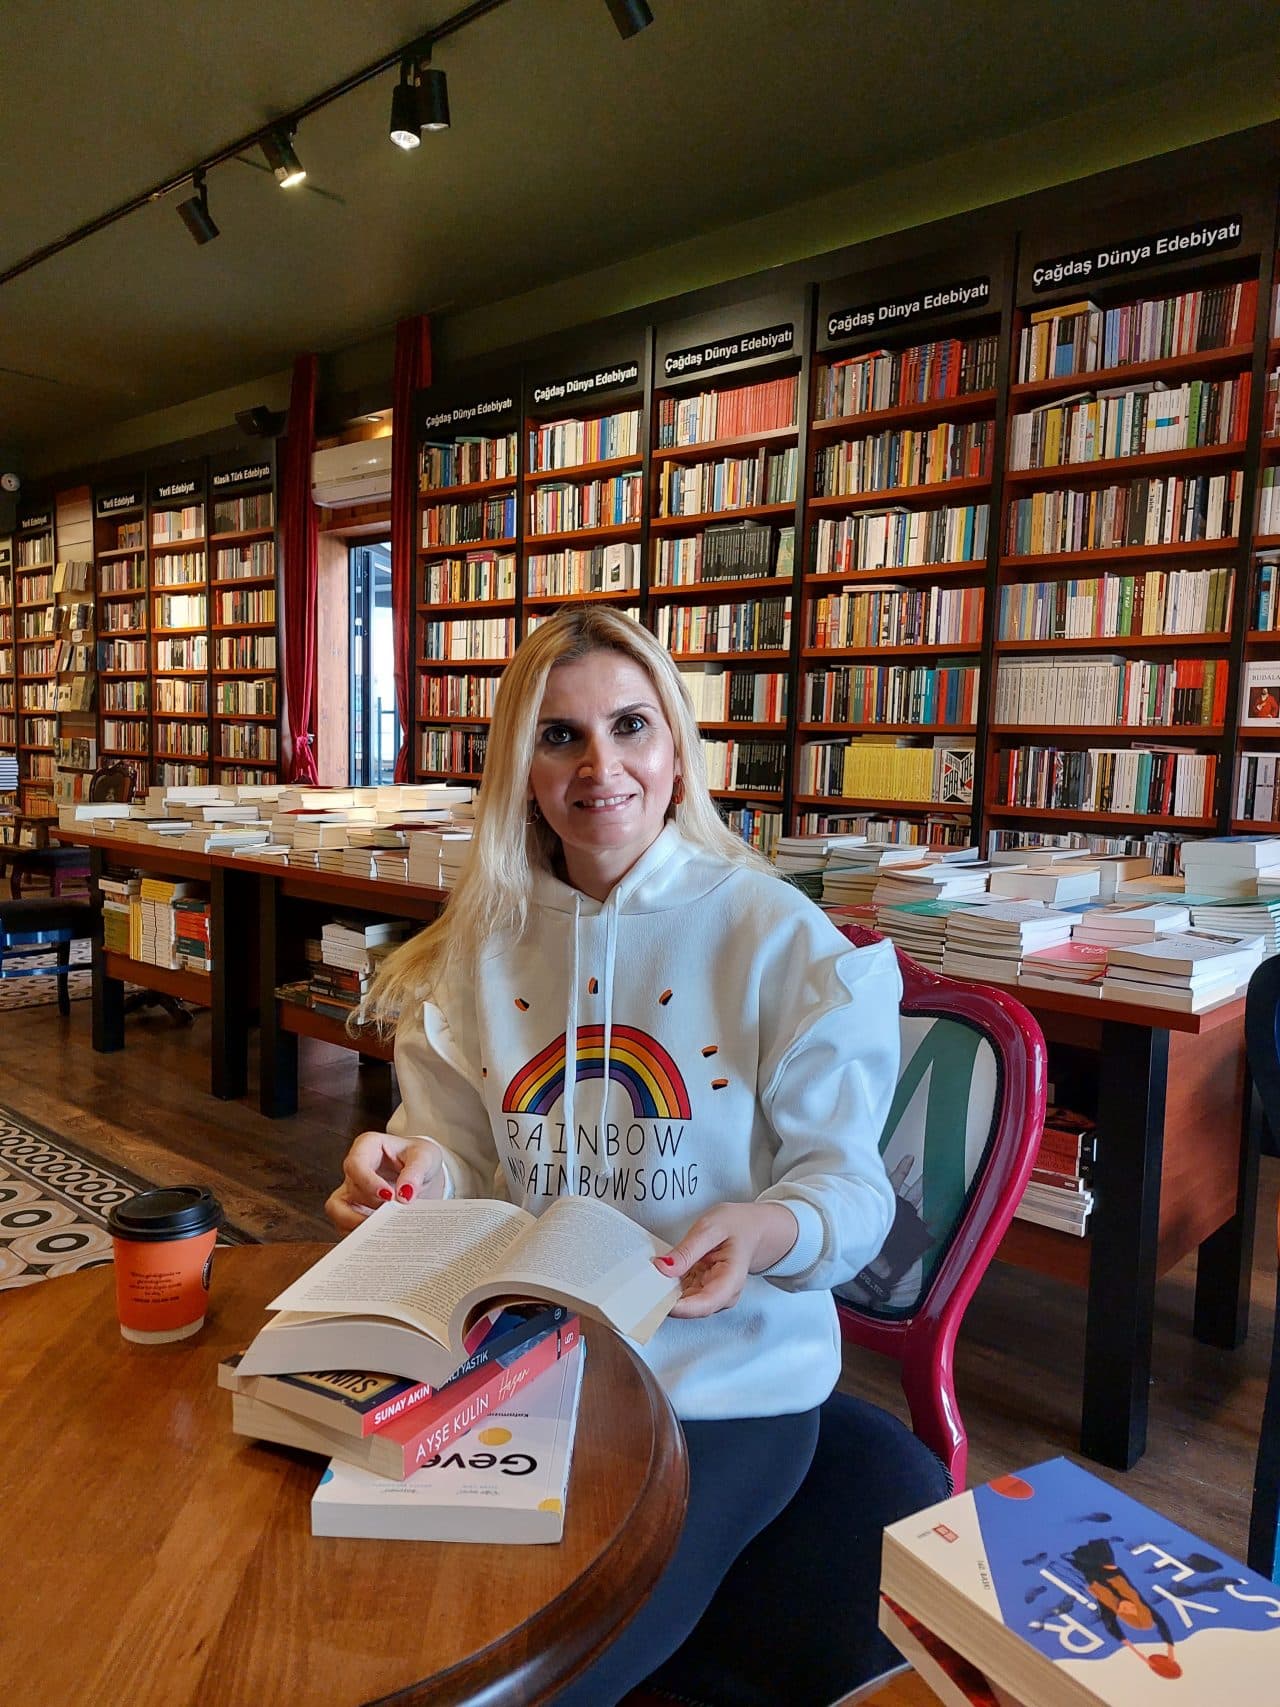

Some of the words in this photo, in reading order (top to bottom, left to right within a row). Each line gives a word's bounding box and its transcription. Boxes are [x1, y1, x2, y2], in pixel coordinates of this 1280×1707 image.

[1033, 260, 1092, 286] Çağdaş
[1097, 246, 1150, 268] Dünya
[1156, 223, 1240, 255] Edebiyatı
[828, 312, 875, 334] Çağdaş
[878, 301, 920, 320] Dünya
[923, 283, 988, 309] Edebiyatı
[665, 353, 702, 373] Çağdaş
[704, 344, 738, 360] Dünya
[740, 330, 792, 352] Edebiyatı
[534, 383, 566, 403] Çağdaş
[566, 379, 594, 397] Dünya
[595, 366, 638, 387] Edebiyatı
[425, 412, 452, 430] Çağdaş
[453, 407, 476, 421] Dünya
[477, 398, 512, 415] Edebiyatı
[506, 1119, 685, 1157] RAINBOW
[374, 1400, 406, 1425] SUNAY
[407, 1384, 430, 1408] AKIN
[415, 1427, 449, 1463] AYŞE
[453, 1393, 489, 1434] KULİN
